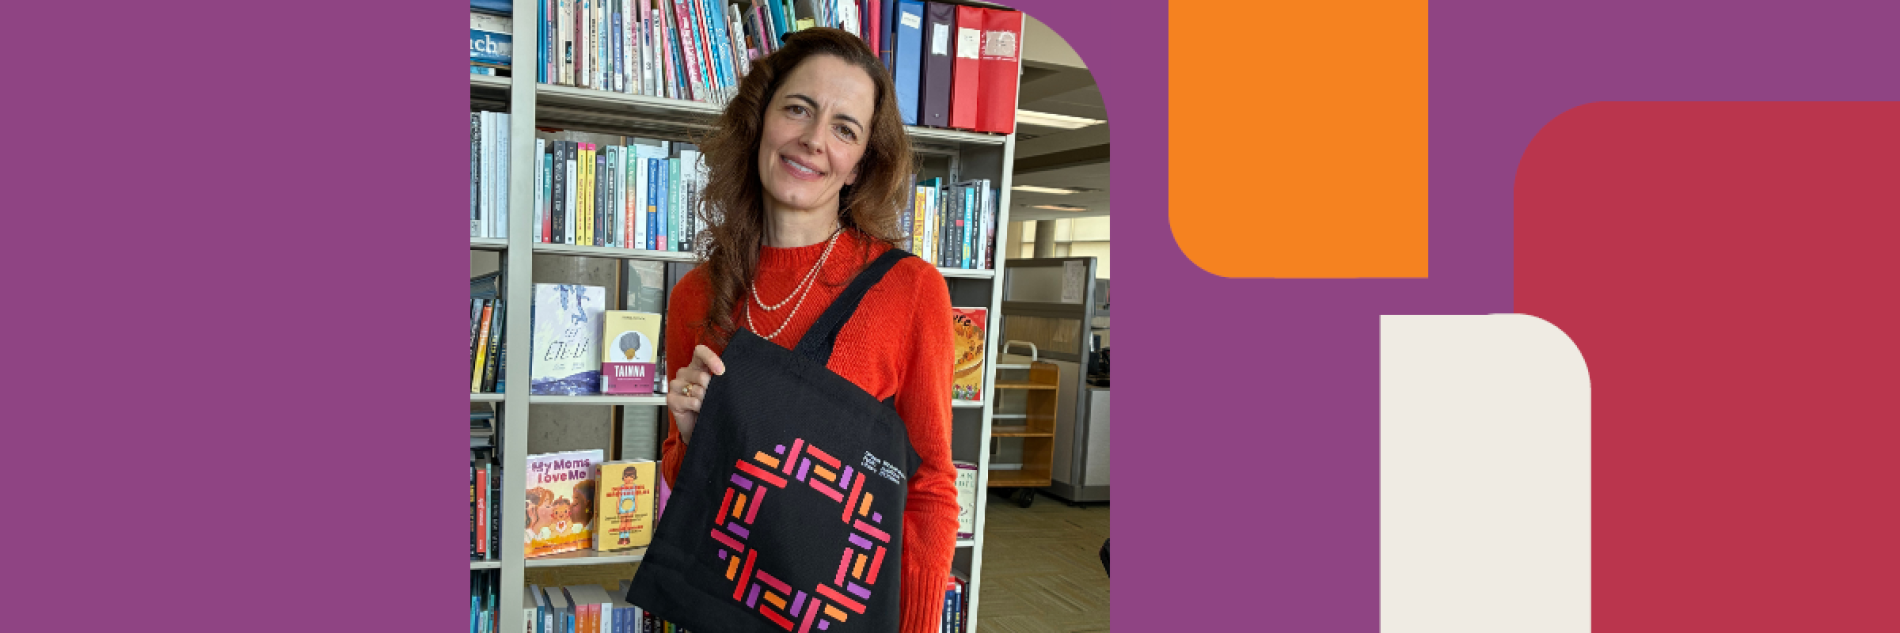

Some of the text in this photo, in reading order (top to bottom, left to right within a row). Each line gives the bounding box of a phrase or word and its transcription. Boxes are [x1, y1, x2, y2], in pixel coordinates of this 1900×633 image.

[614, 365, 646, 378] TAINNA
[532, 458, 591, 476] My Moms
[537, 469, 587, 484] Love Me
